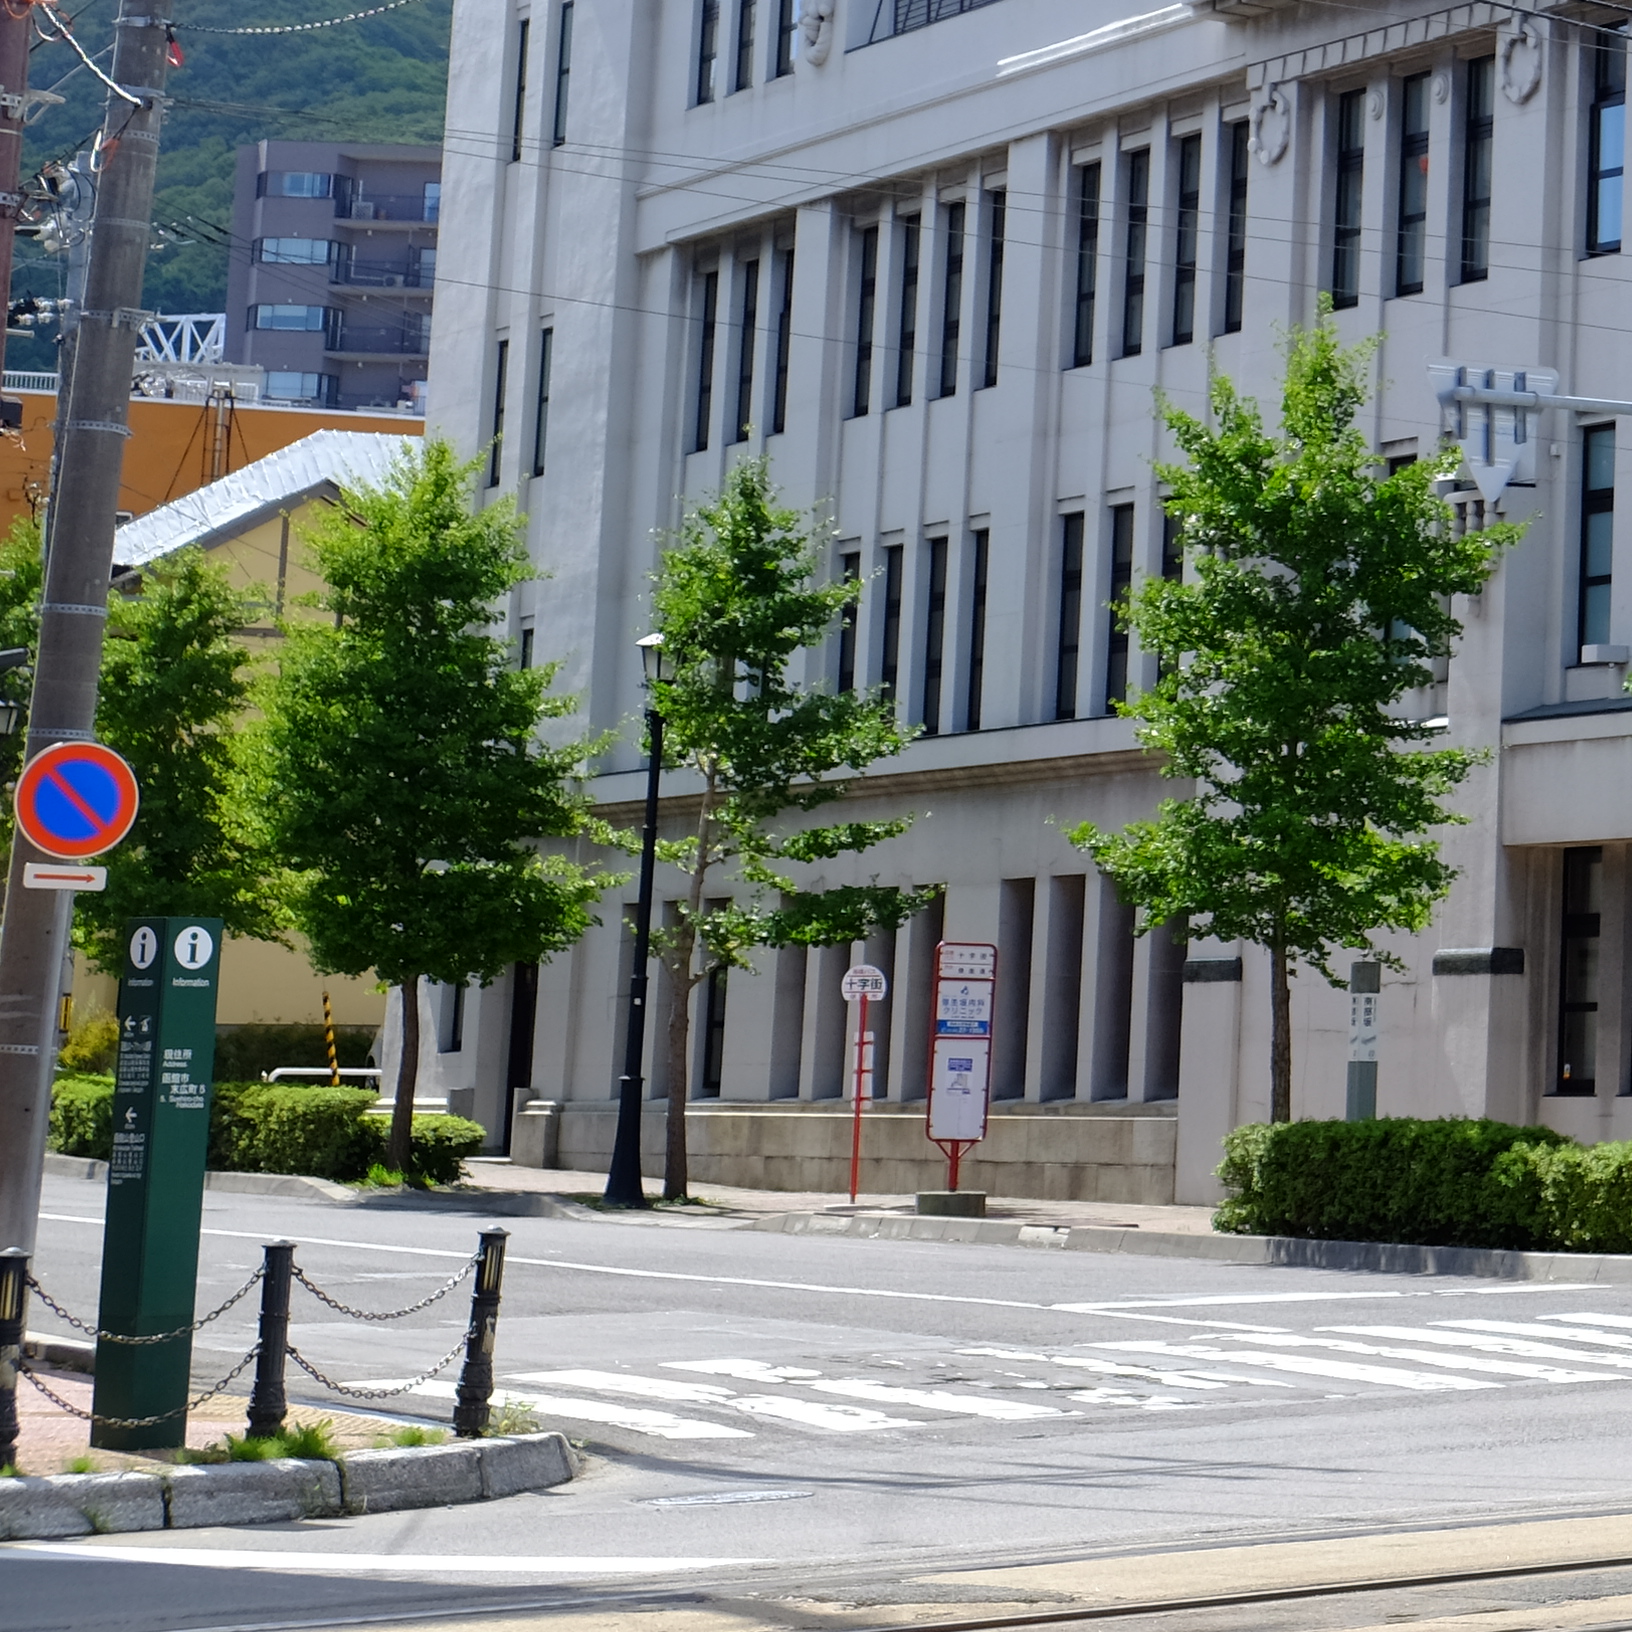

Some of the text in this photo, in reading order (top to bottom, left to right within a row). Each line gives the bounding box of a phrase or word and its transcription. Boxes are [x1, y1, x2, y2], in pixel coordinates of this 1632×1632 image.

[172, 977, 210, 987] Information
[845, 978, 882, 990] 十字街
